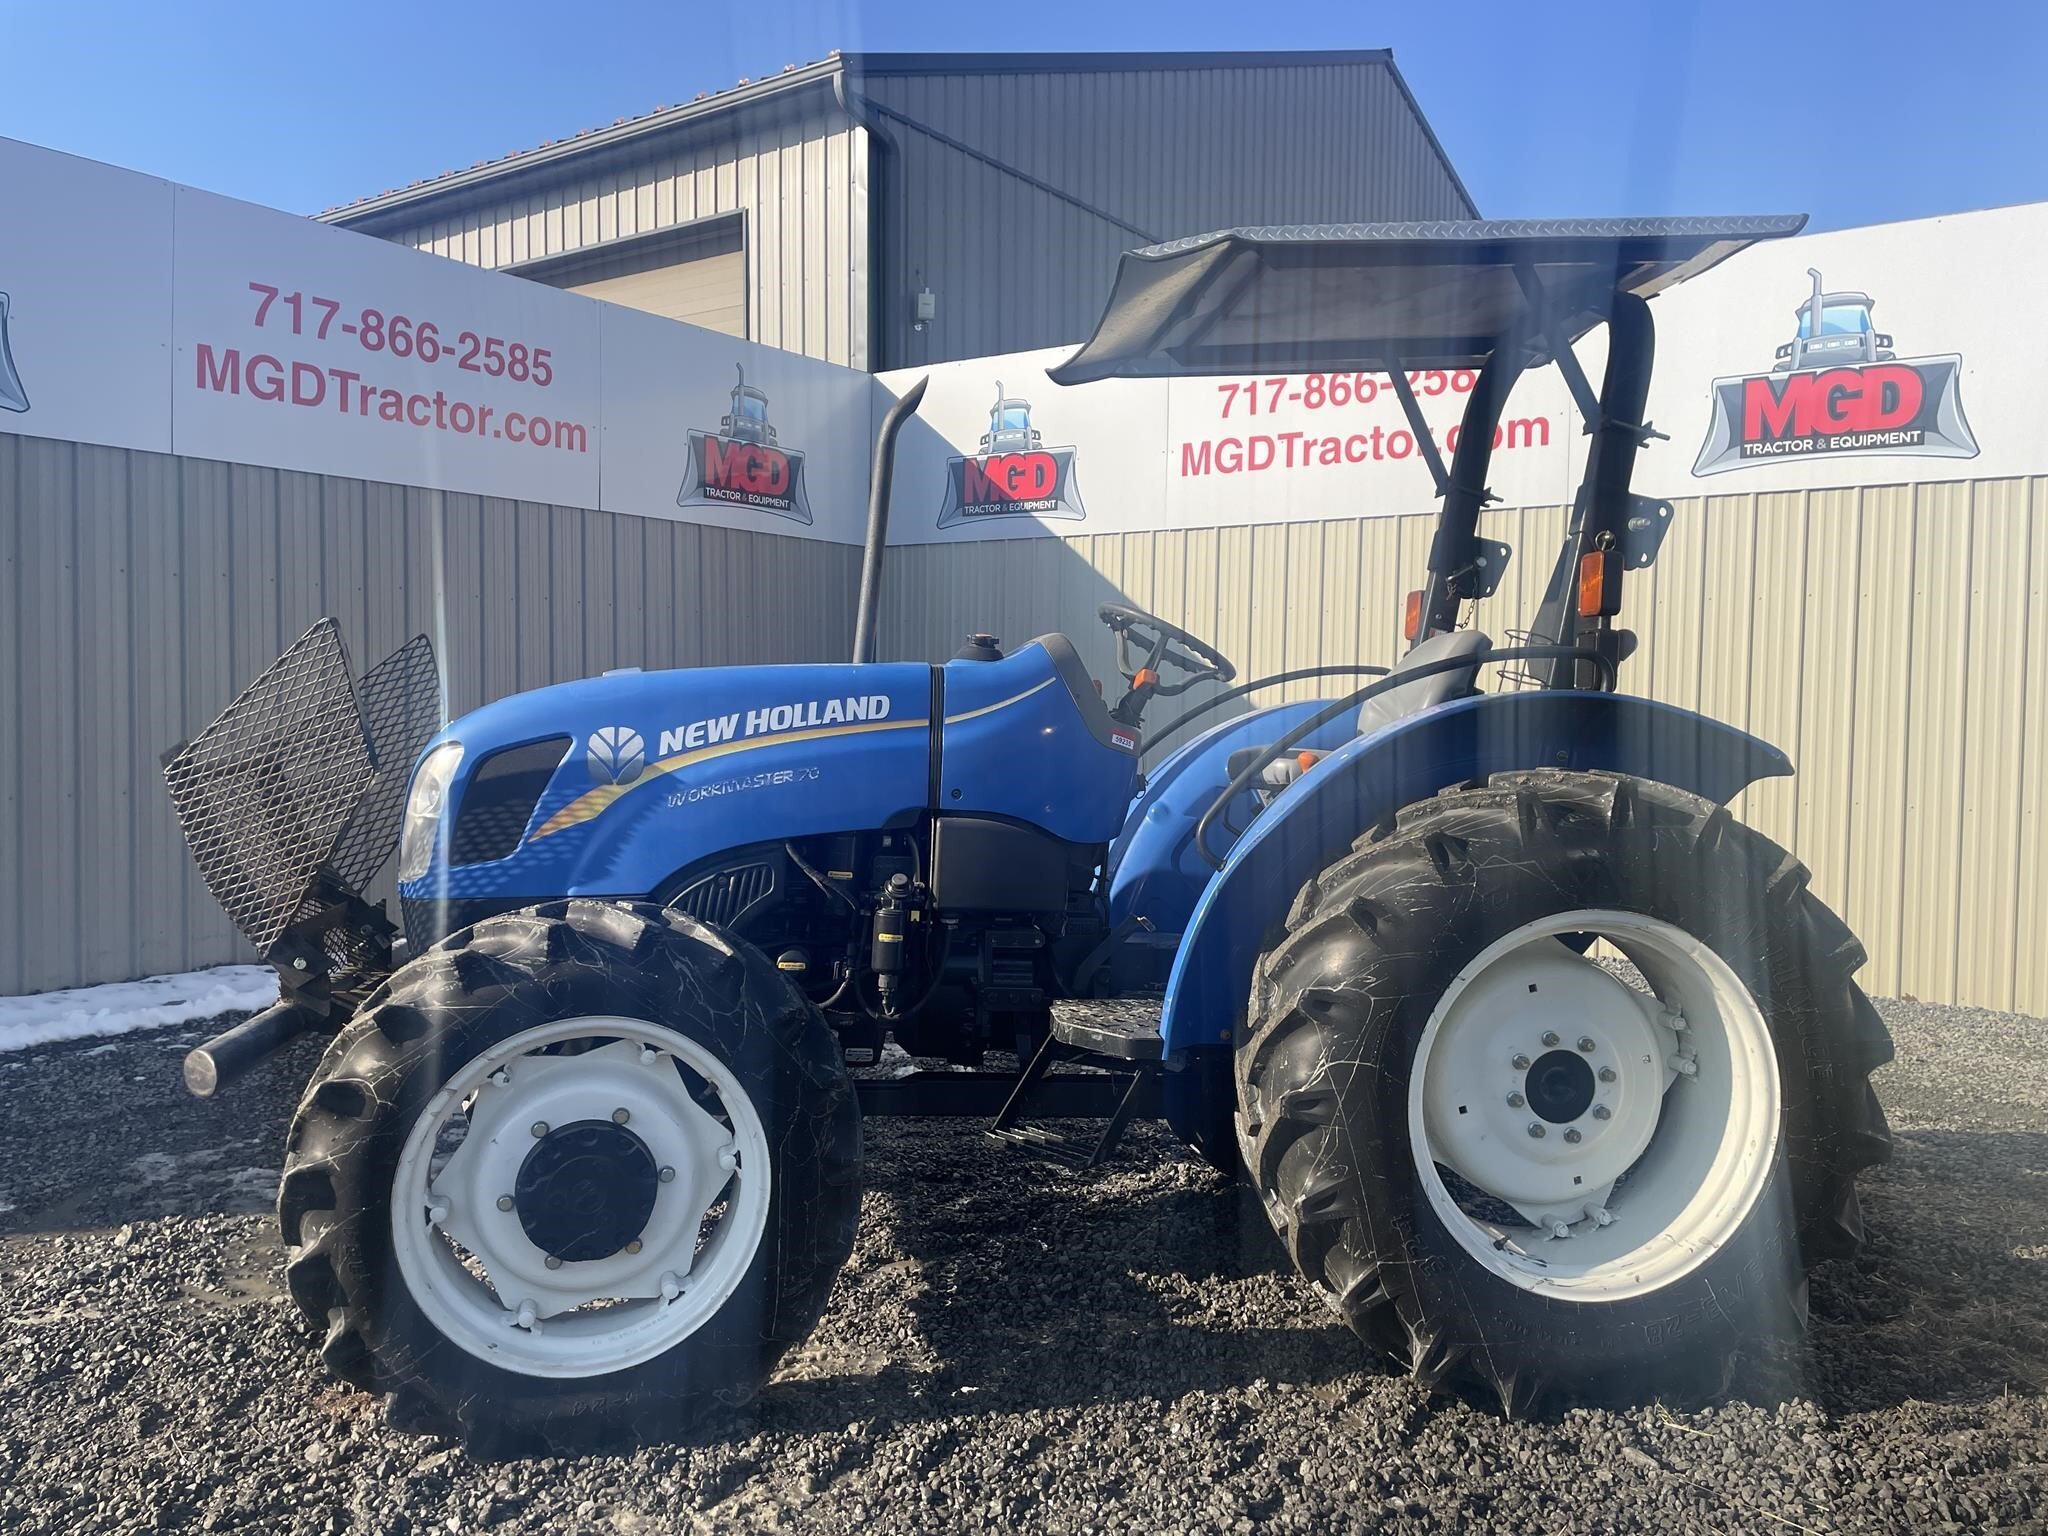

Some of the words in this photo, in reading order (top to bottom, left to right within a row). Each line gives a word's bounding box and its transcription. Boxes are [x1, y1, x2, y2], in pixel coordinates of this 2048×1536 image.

[248, 281, 553, 387] 717-866-2585
[196, 343, 587, 453] MGDTractor.com
[1741, 363, 1926, 443] MGD
[704, 435, 791, 496] MGD
[1744, 438, 1813, 456] TRACTOR
[1816, 438, 1828, 450] &
[1829, 430, 1922, 450] EQUIPMENT
[705, 486, 741, 501] TRACTOR
[748, 494, 789, 508] EQUIPMENT
[963, 451, 1058, 504] MGD
[964, 503, 1001, 515] TRACTOR
[1009, 499, 1057, 512] EQUIPMENT
[658, 712, 741, 757] NEW
[744, 694, 891, 736] HOLLAND
[667, 769, 794, 809] WORKMASTER
